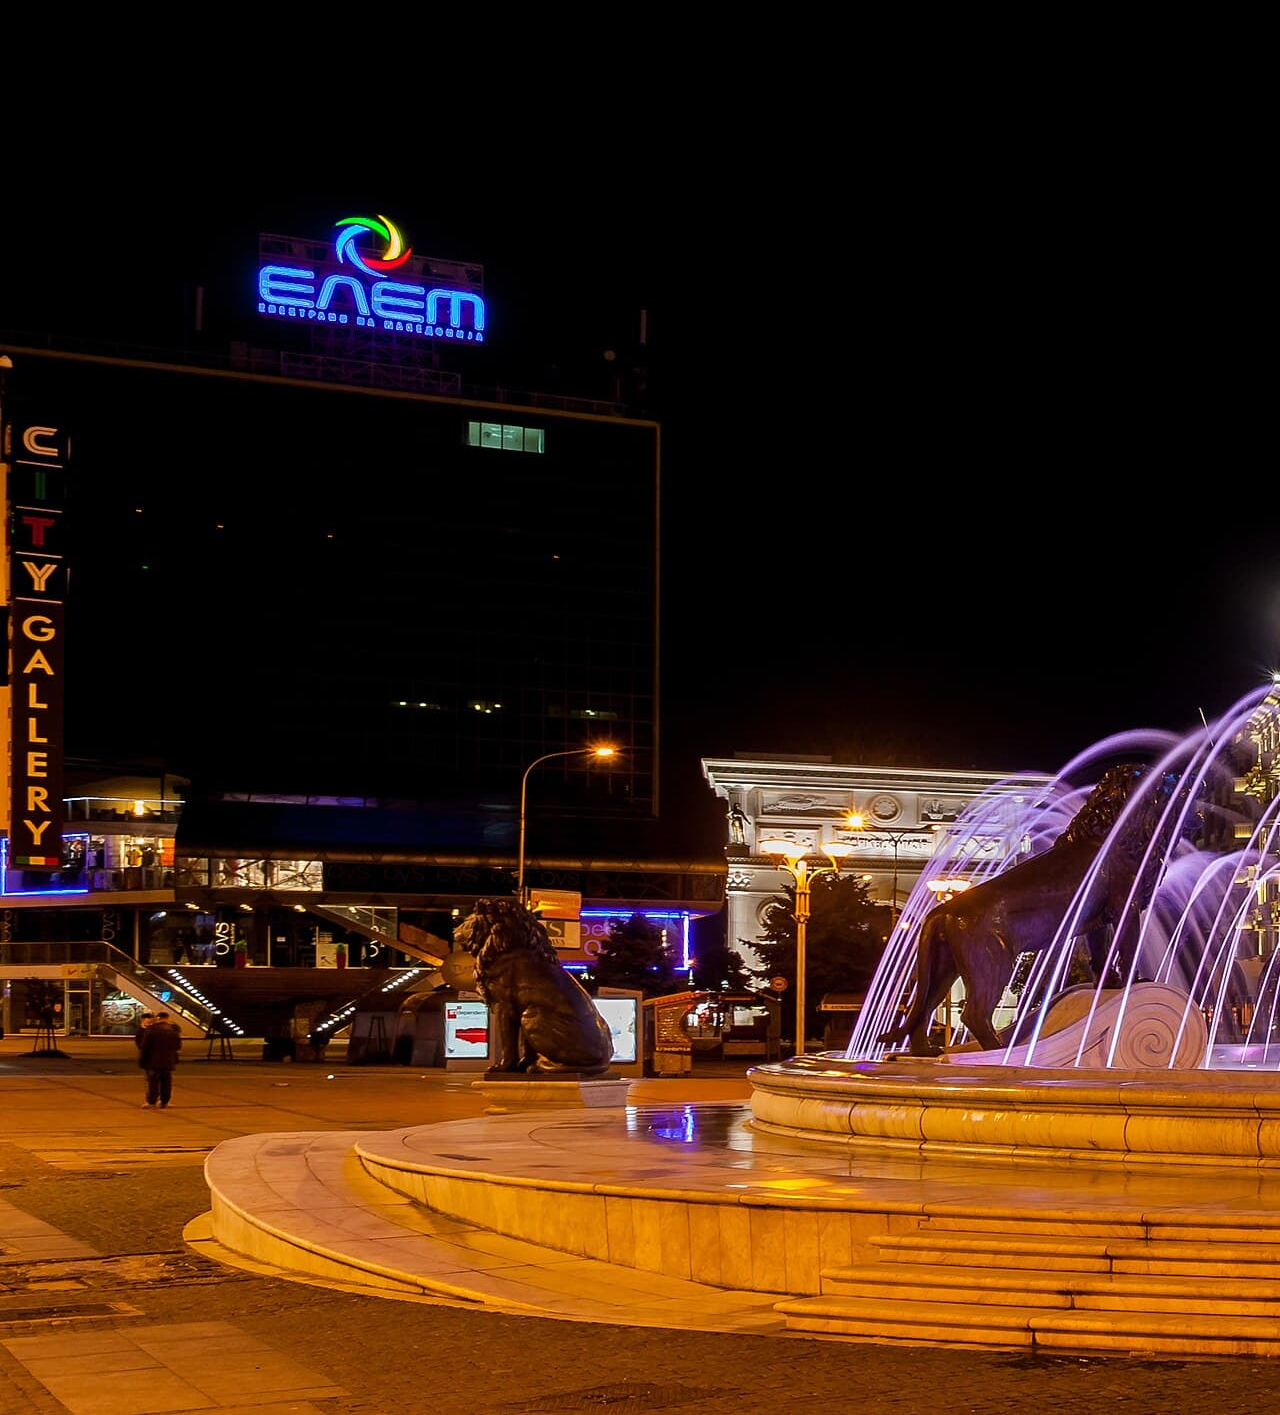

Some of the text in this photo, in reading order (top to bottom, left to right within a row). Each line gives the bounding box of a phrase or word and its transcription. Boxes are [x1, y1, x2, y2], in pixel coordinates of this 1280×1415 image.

[22, 426, 58, 846] CITY GALLERY
[215, 922, 230, 956] OVS
